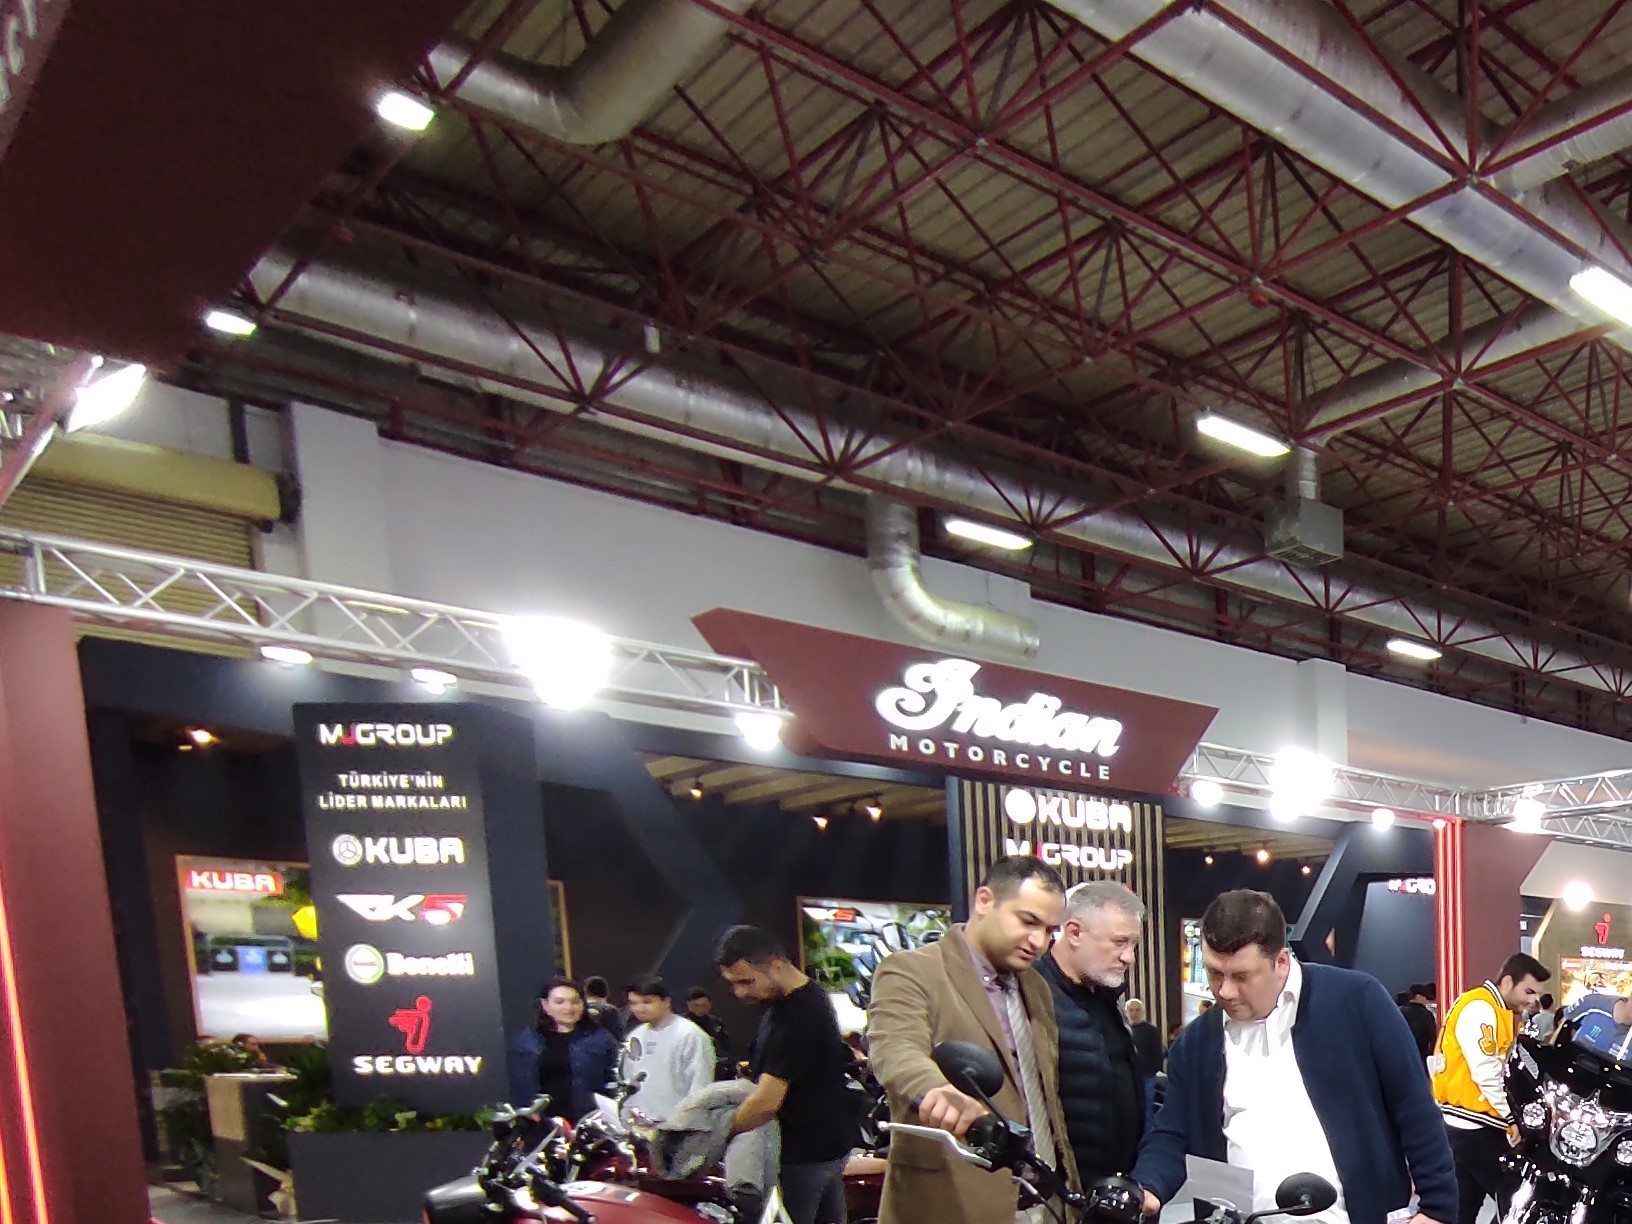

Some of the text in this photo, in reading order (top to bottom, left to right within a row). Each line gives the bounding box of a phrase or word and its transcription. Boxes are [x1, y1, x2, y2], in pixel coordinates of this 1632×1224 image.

[875, 658, 1123, 758] Indian
[888, 733, 1110, 780] MOTORCYCLE
[318, 791, 467, 809] LİDER MARKALARI
[1037, 794, 1132, 833] KUBA
[364, 836, 465, 864] KUBA
[191, 870, 276, 892] KUBA
[353, 1055, 482, 1075] SEGWAY
